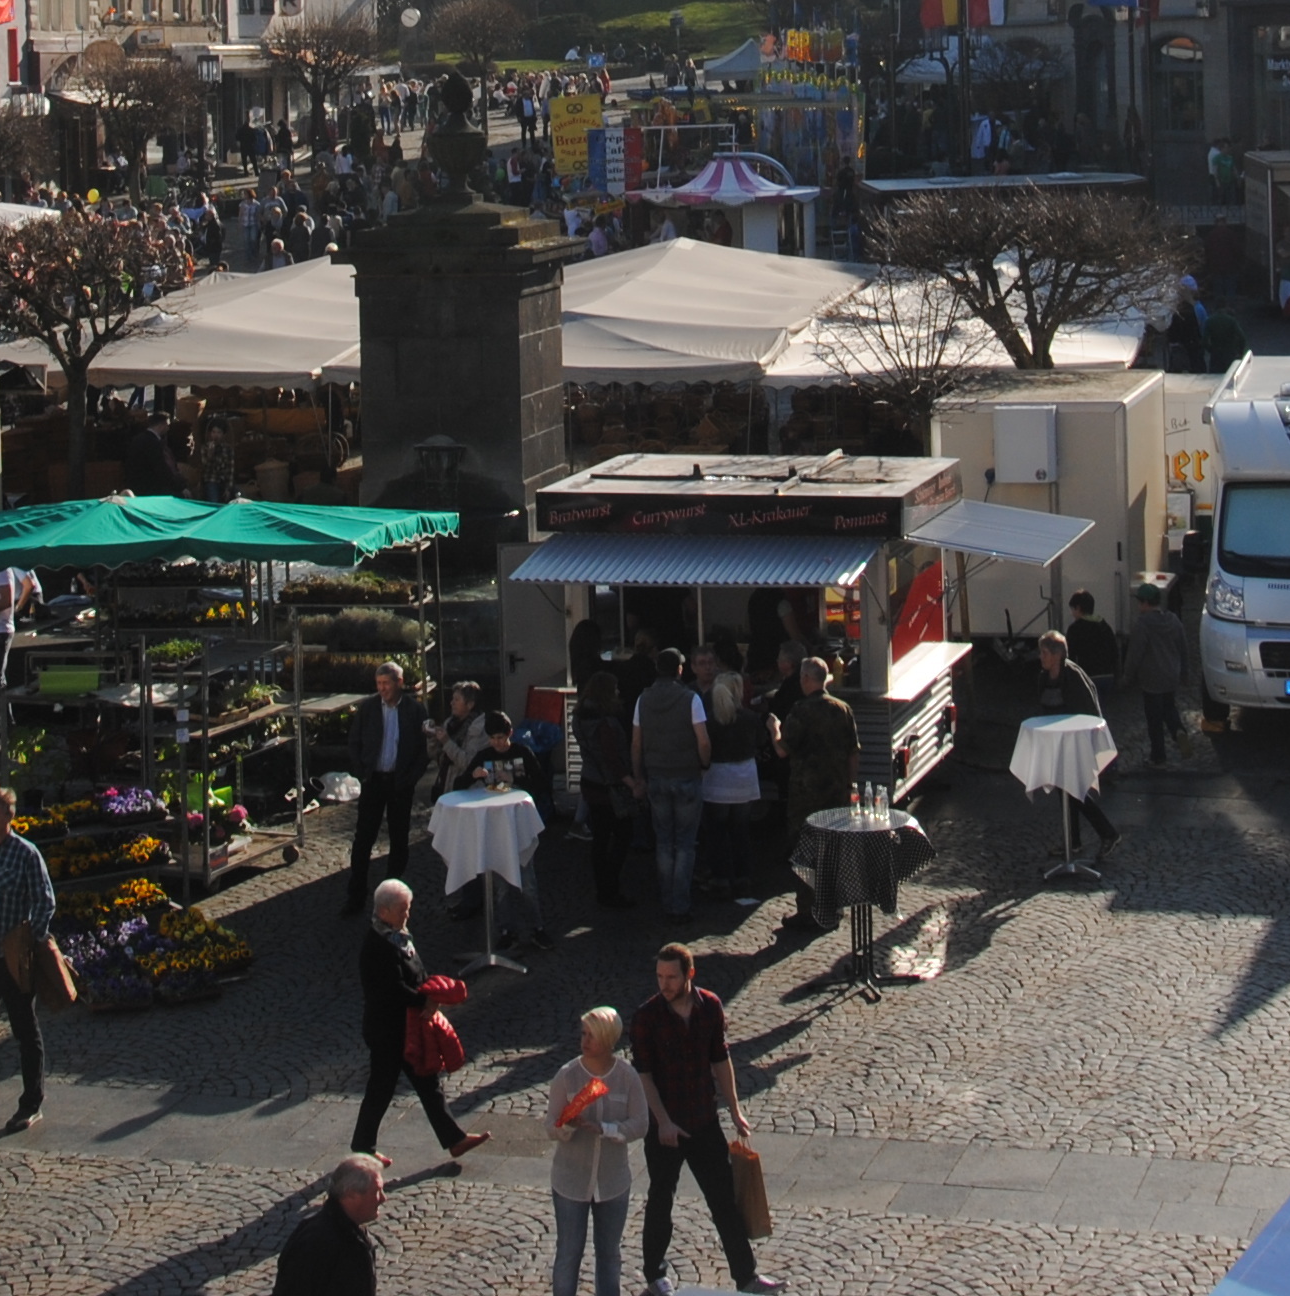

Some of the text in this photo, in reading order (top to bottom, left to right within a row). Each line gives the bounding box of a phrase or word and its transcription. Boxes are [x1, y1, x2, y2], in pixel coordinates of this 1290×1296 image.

[549, 503, 887, 530] Bratwurst Currywurst XL-Krakauer Pommes
